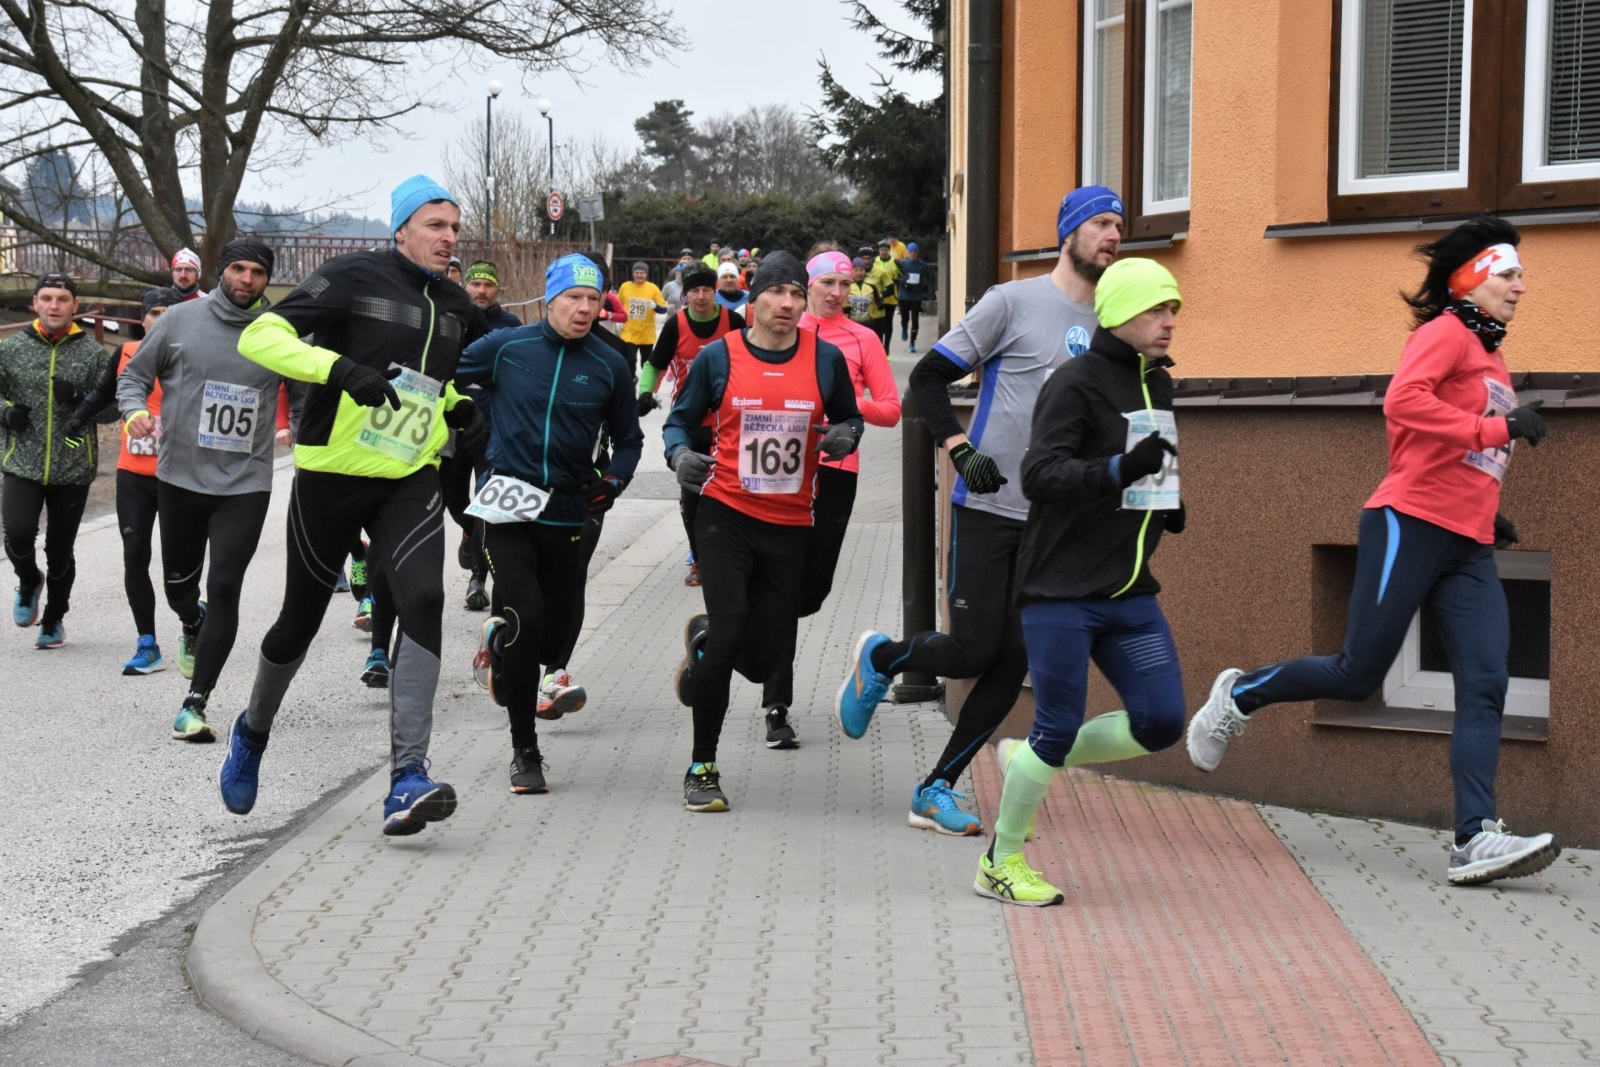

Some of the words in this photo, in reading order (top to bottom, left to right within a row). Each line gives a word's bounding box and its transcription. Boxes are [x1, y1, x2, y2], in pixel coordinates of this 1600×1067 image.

[629, 304, 645, 315] 219
[206, 383, 230, 393] ZIMNÍ
[241, 396, 257, 404] LIGA
[784, 399, 815, 407] MARATON
[205, 402, 254, 437] 105
[370, 398, 432, 446] 673
[745, 414, 773, 422] ZIMNÍ
[744, 422, 784, 432] BĚŽECKÁ
[788, 424, 807, 432] LIGA
[128, 434, 162, 456] 63
[745, 437, 801, 476] 163
[479, 478, 542, 521] 662
